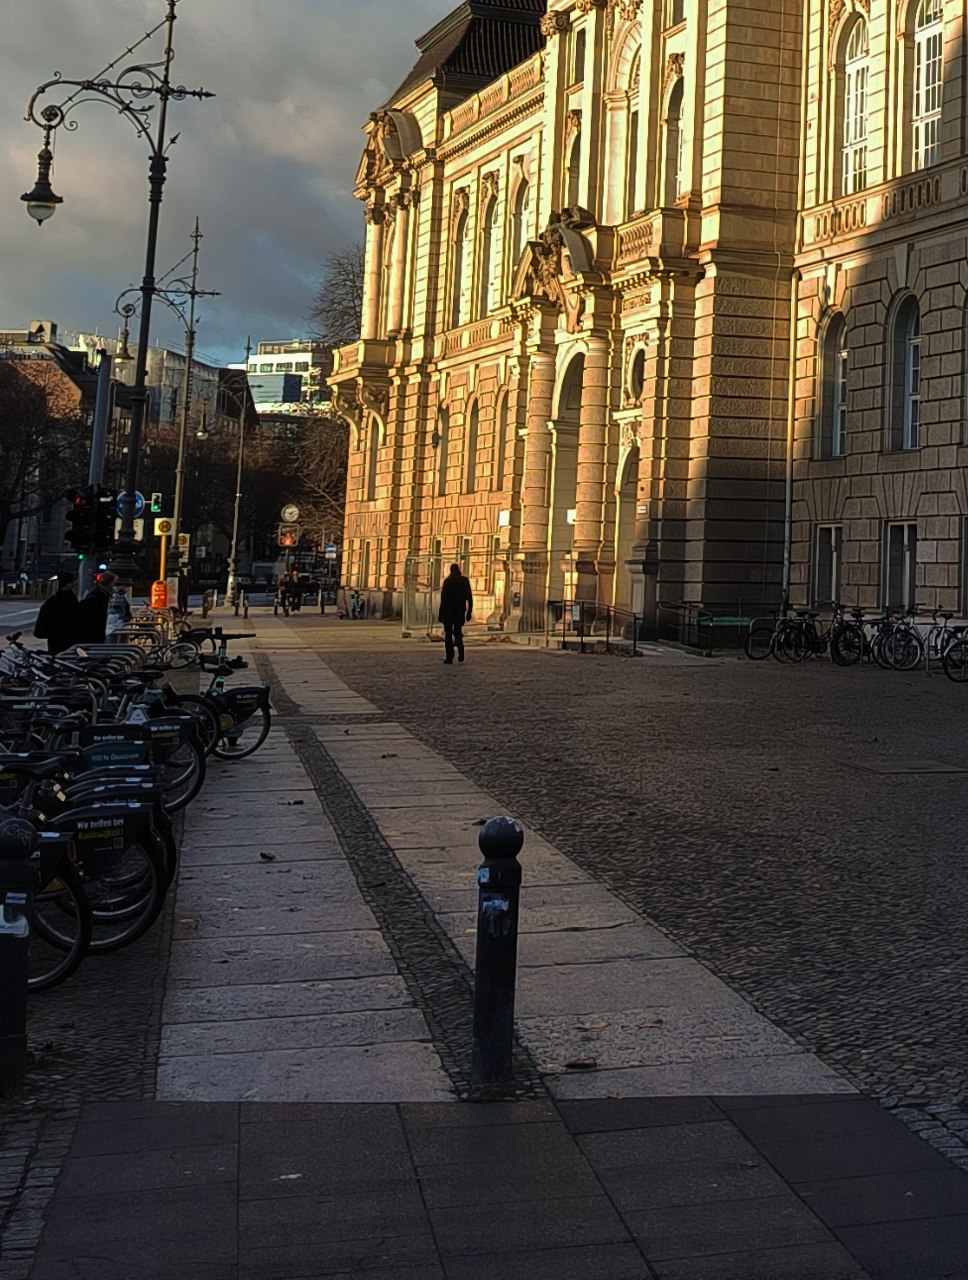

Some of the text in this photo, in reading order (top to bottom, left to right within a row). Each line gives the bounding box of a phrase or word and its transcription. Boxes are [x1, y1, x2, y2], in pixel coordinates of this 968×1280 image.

[77, 817, 124, 830] Wir helfen bei
